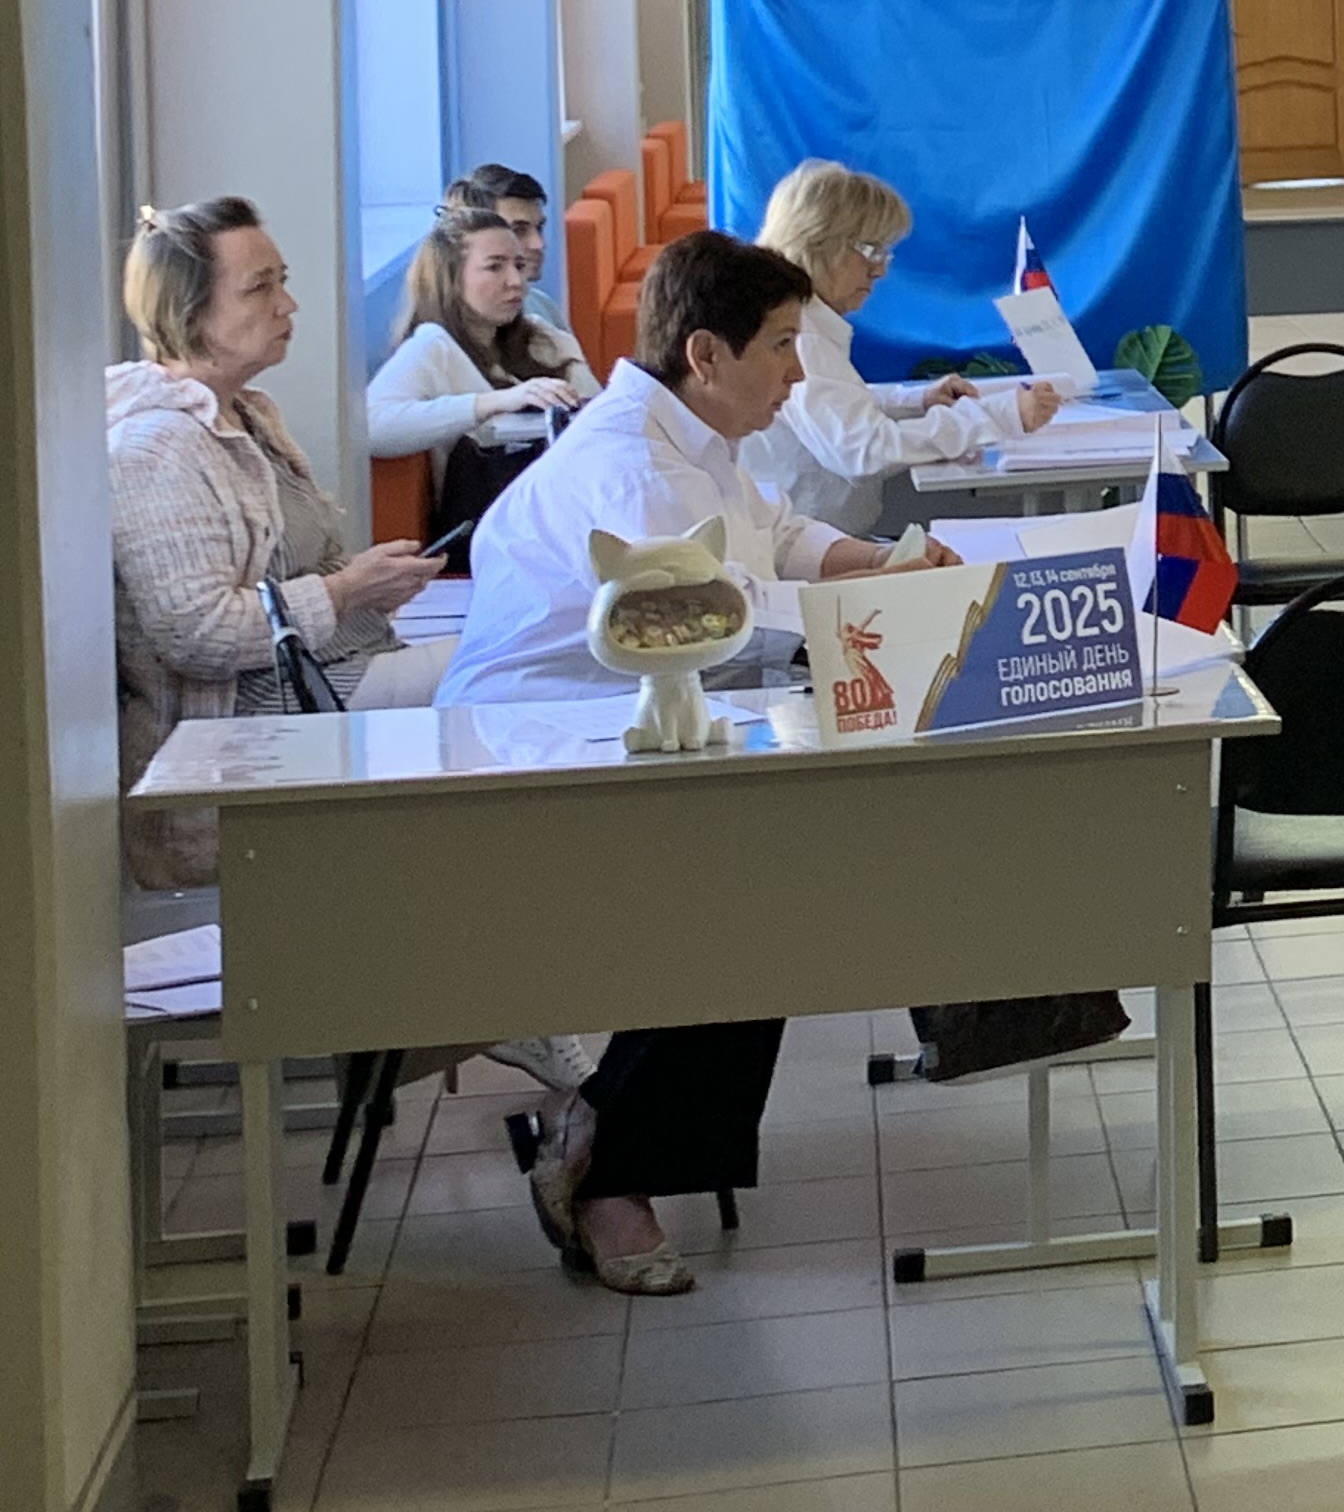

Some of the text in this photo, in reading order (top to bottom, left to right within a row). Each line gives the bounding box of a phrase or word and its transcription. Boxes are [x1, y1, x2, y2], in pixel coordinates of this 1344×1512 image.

[1060, 563, 1117, 582] сентября
[1016, 581, 1124, 645] 2025
[998, 642, 1130, 683] ЕДИНЫЙ ДЕНЬ
[833, 678, 866, 714] 80
[1001, 669, 1133, 706] голосования
